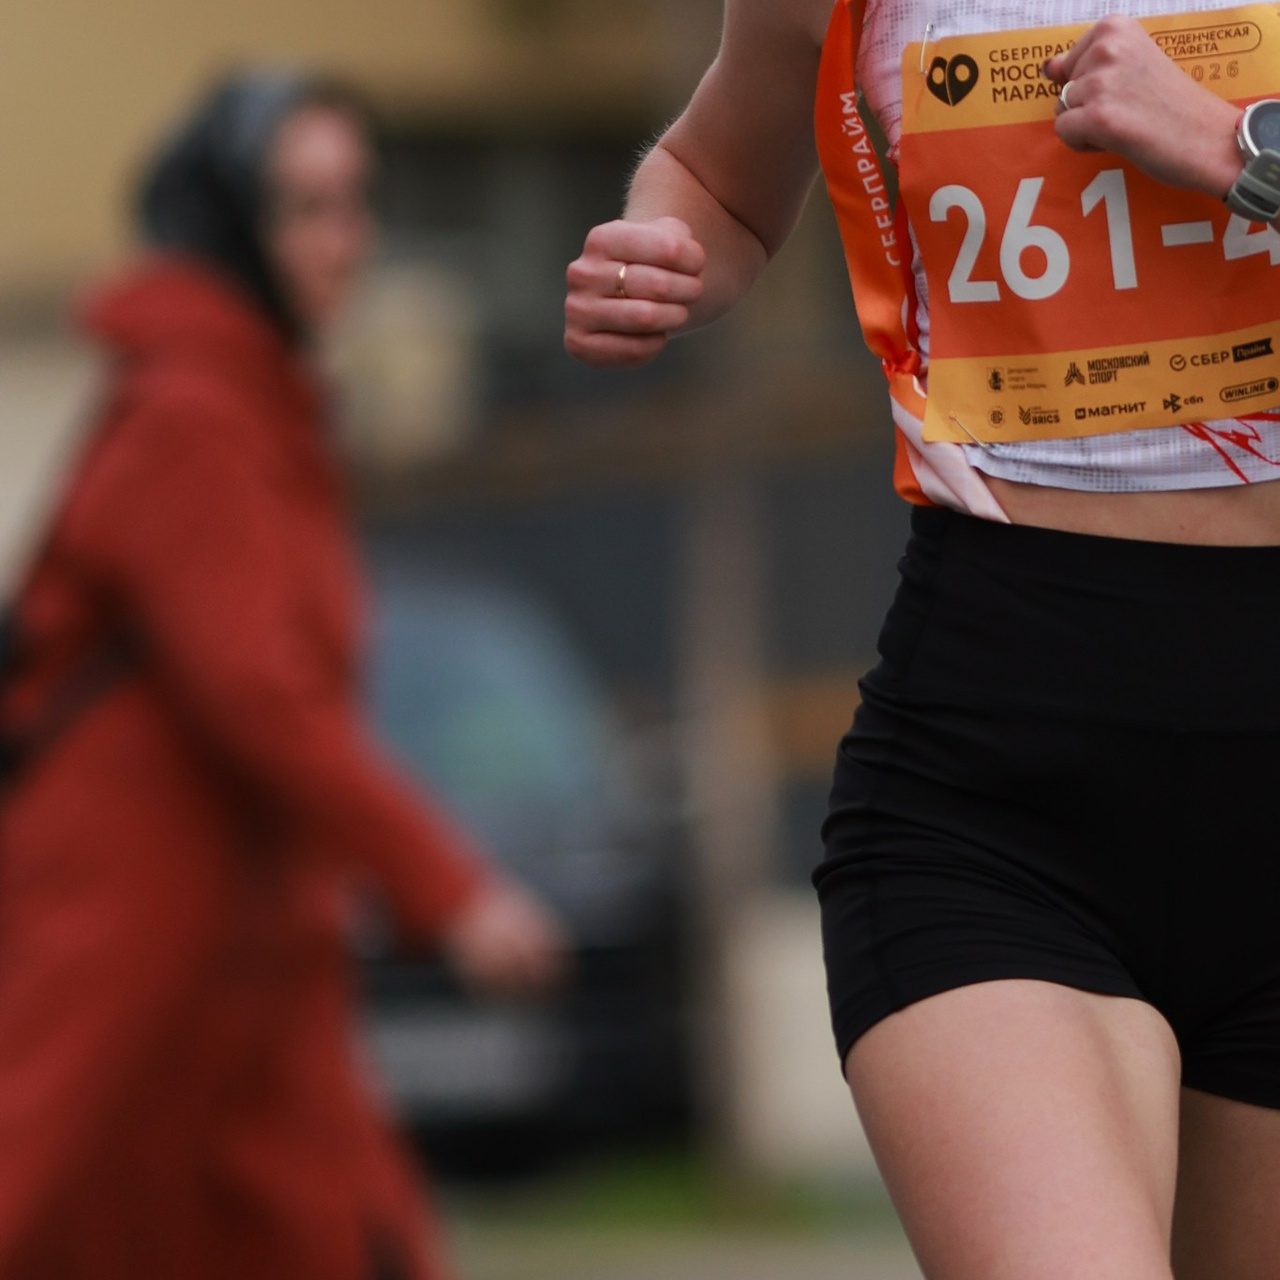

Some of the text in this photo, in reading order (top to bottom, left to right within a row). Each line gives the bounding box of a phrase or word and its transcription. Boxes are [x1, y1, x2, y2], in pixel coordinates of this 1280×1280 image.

[1155, 26, 1250, 47] СТУДЕНЧЕСКАЯ
[988, 39, 1076, 63] СБЕРПРА
[1163, 41, 1219, 58] СТАФЕТА
[990, 62, 1043, 84] МОСК
[1180, 60, 1240, 83] 026
[992, 81, 1063, 104] МАРАФ
[1087, 351, 1150, 371] МОСКОВСКИЙ
[1190, 351, 1231, 368] СБЕР
[1088, 369, 1119, 385] СПОРТ
[1224, 382, 1267, 400] WINLINE
